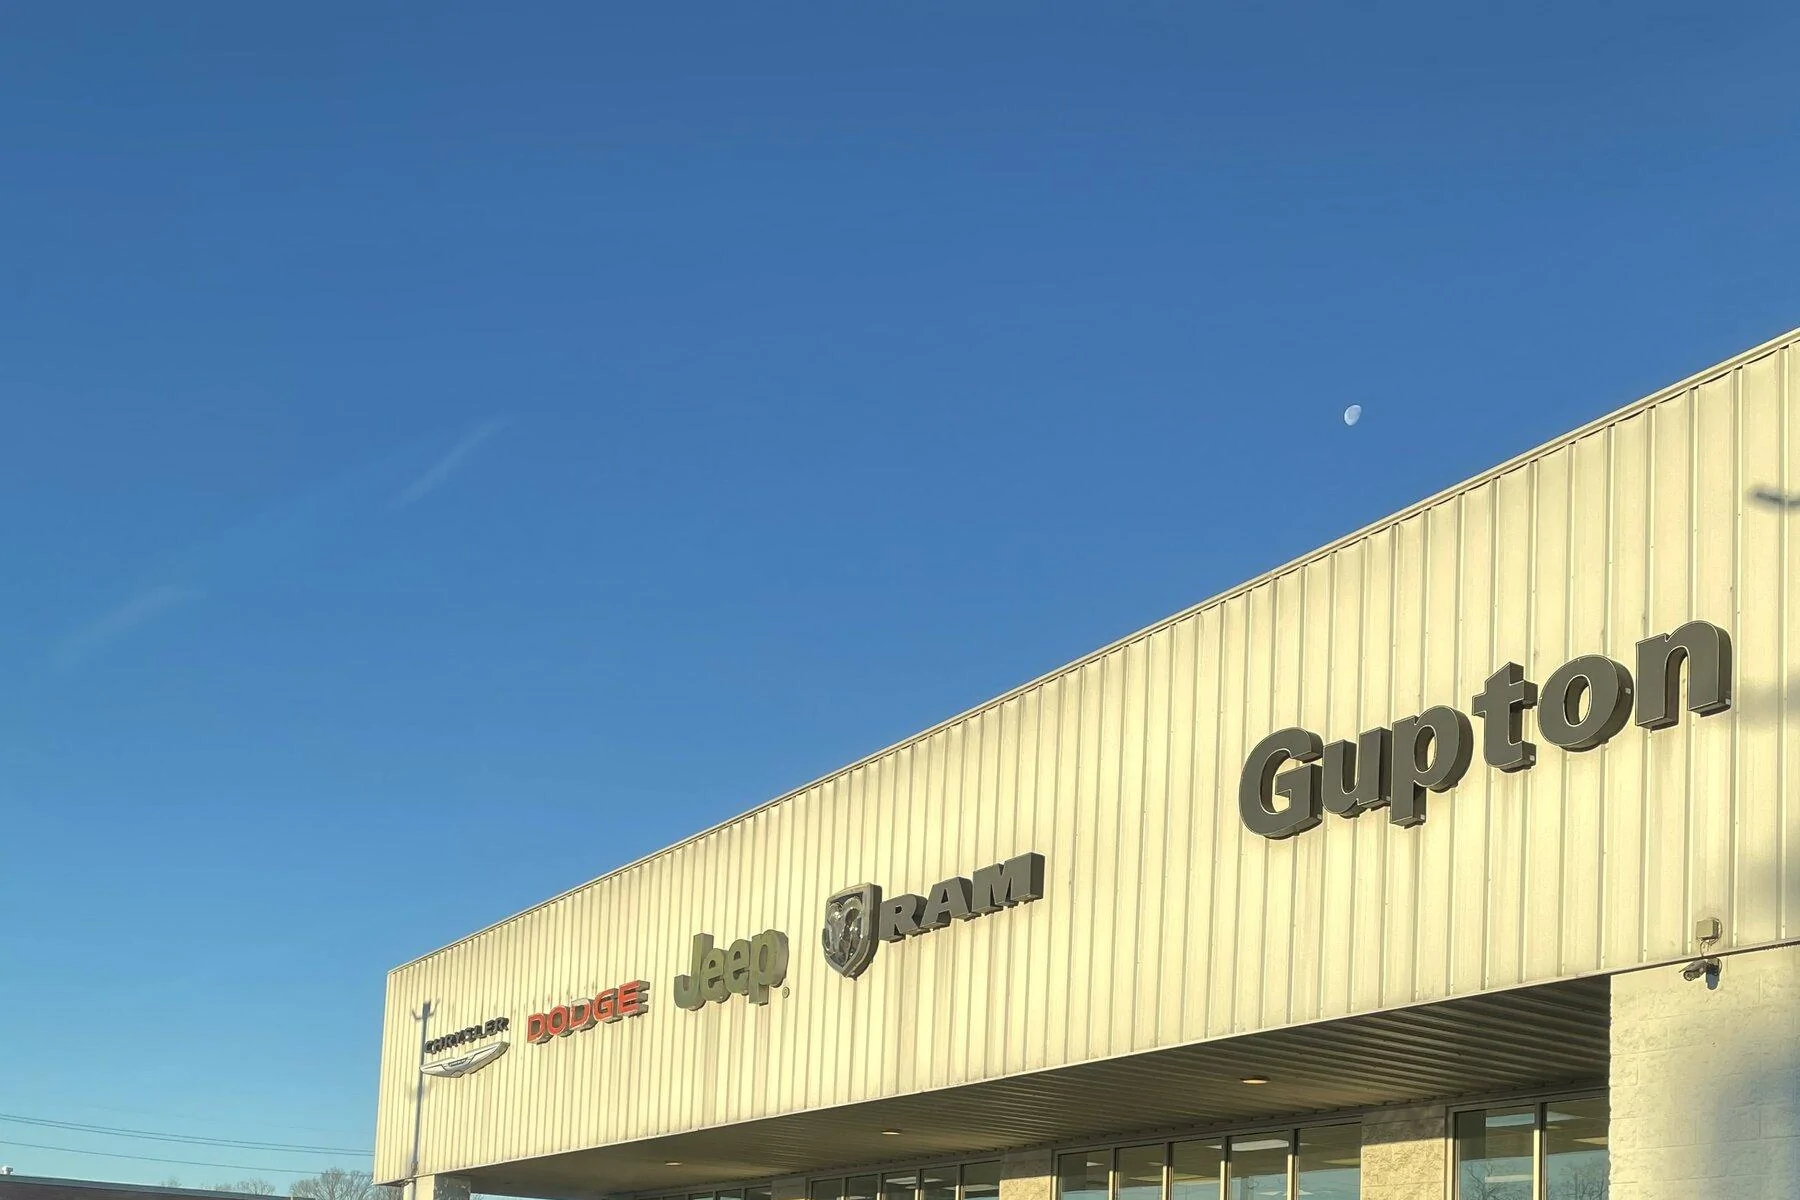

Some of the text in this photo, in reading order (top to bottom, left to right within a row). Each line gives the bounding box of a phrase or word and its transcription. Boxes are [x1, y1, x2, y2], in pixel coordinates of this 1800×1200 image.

[1239, 620, 1732, 840] Gupton
[880, 852, 1045, 942] RAM
[674, 929, 789, 1010] Jeep
[424, 1017, 509, 1054] CHRYSLER
[527, 980, 650, 1045] DODGE
